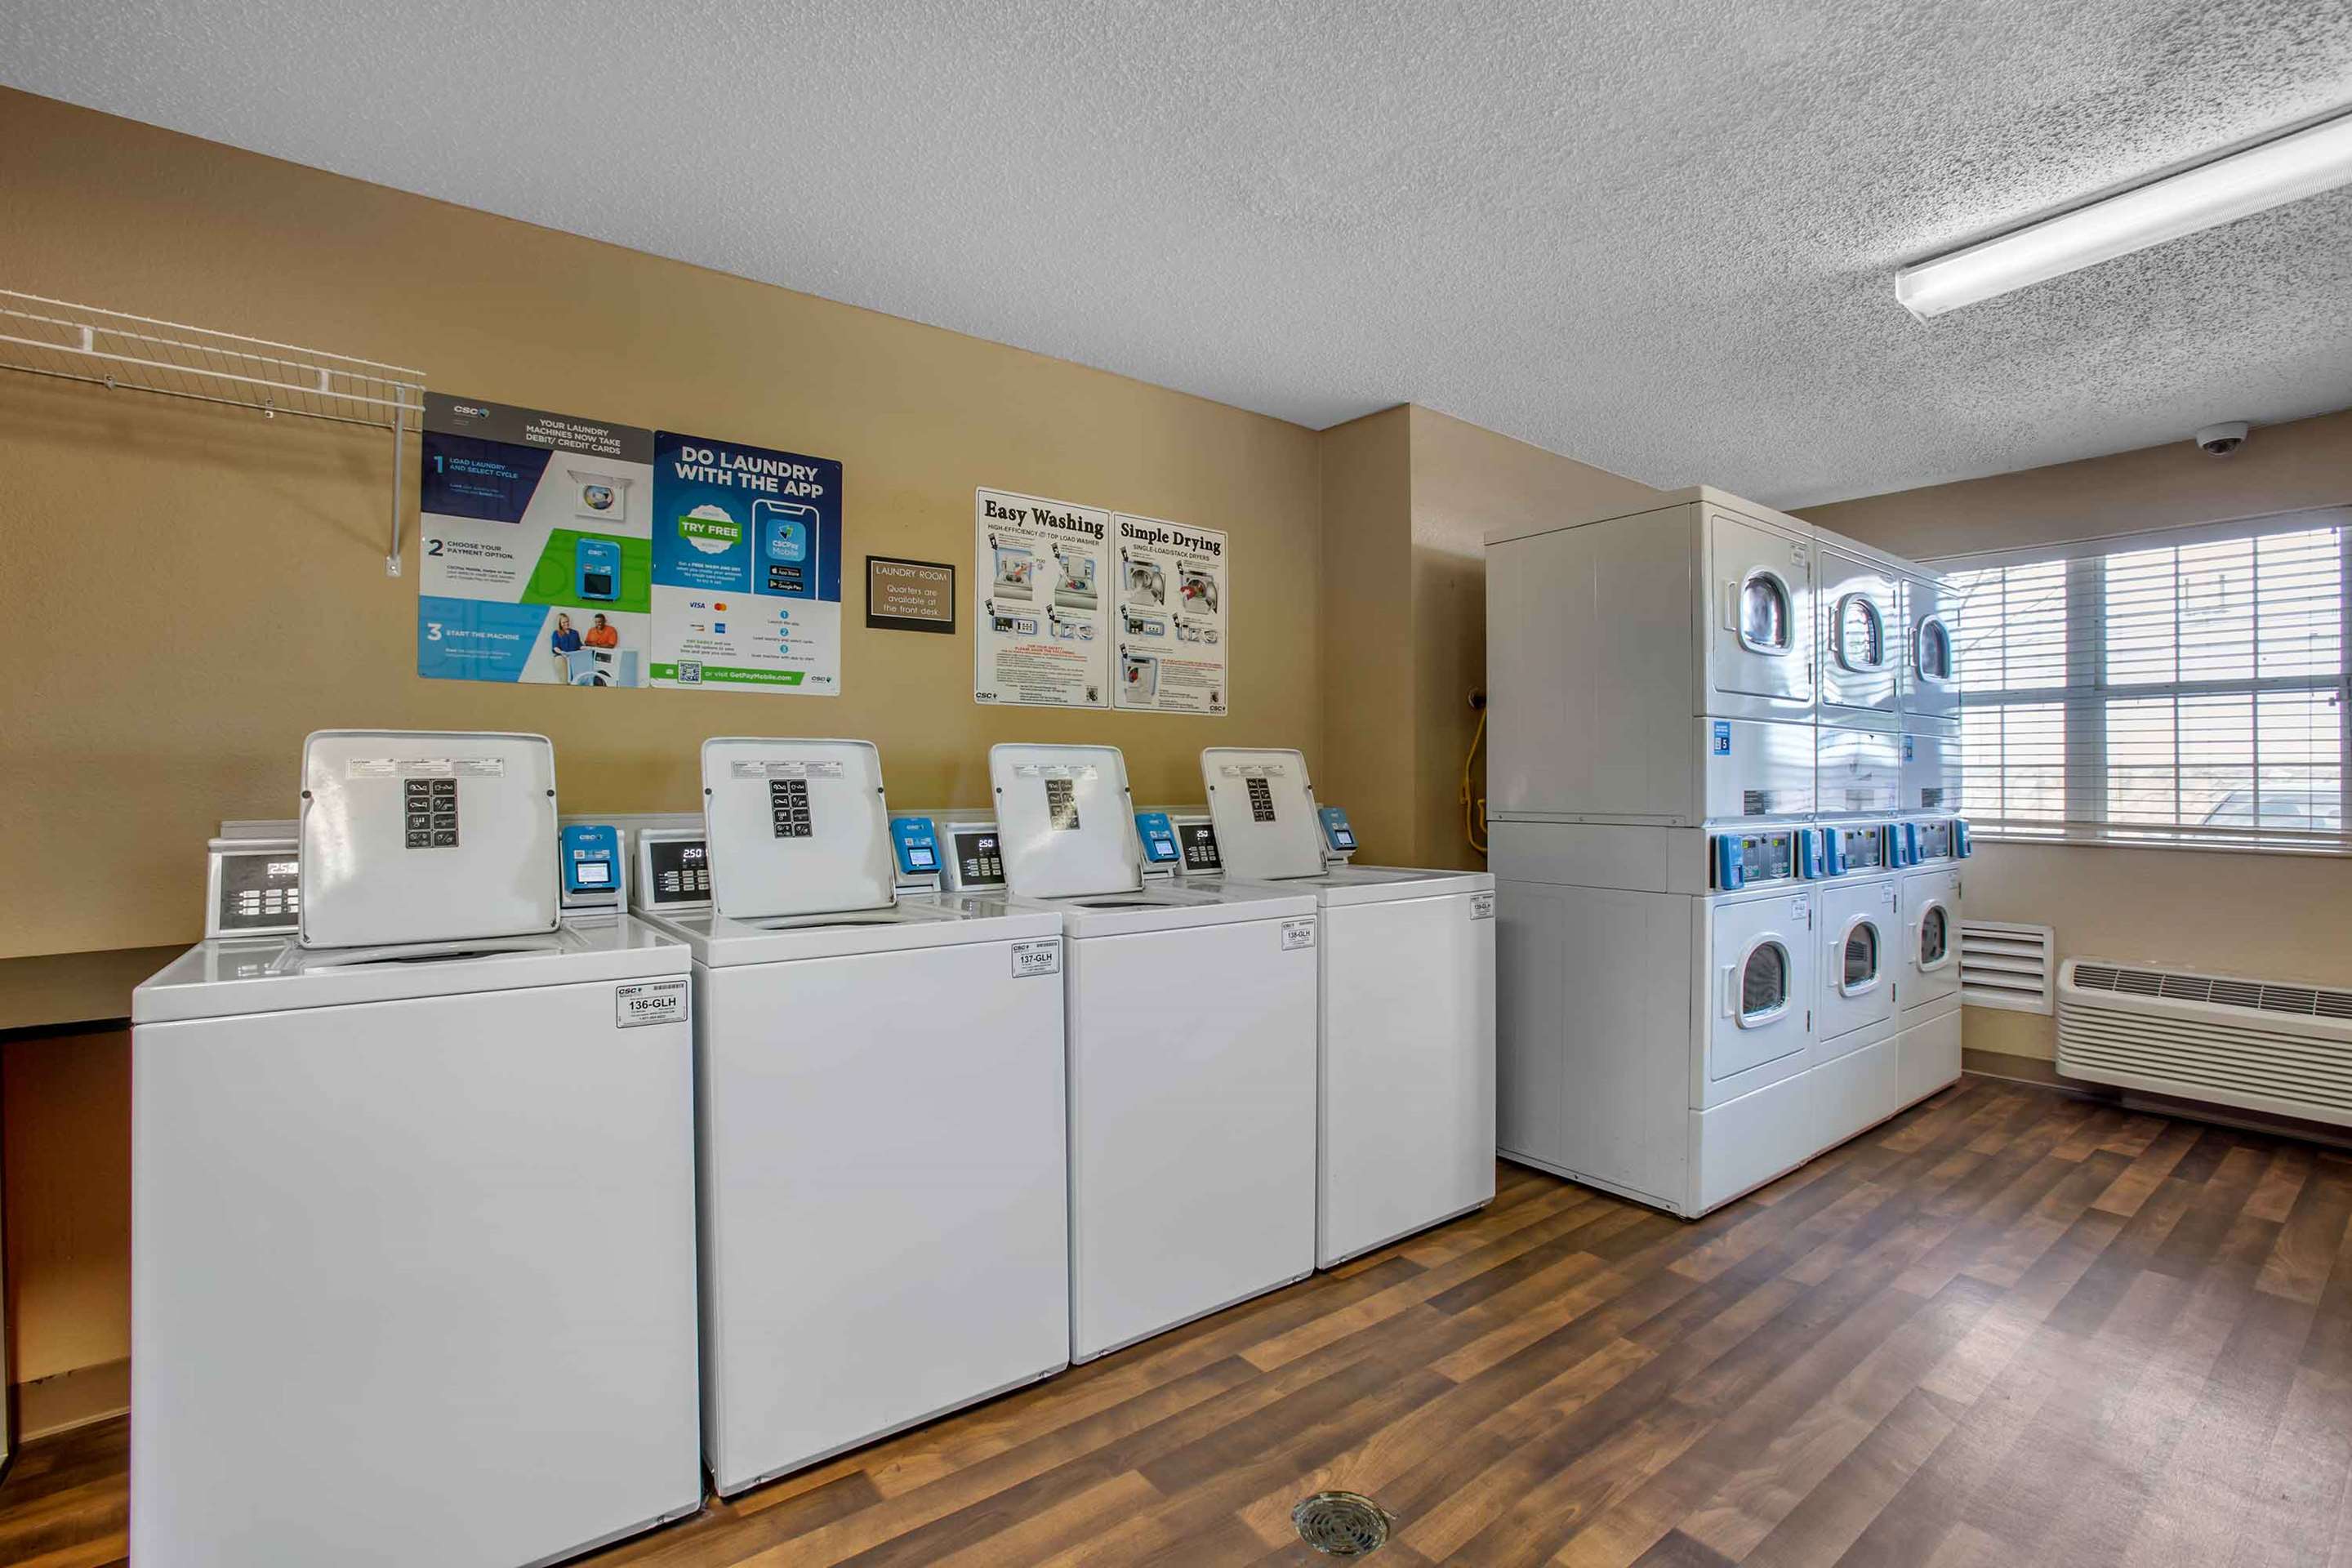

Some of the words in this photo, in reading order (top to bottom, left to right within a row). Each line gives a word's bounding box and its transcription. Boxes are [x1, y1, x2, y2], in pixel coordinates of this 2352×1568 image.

[454, 405, 478, 416] CSC
[540, 419, 565, 429] YOUR
[567, 423, 608, 435] LAUNDRY
[527, 425, 572, 439] MACHINES
[575, 433, 596, 442] NOW
[599, 437, 621, 447] TAKE
[527, 434, 555, 445] DEBIT/
[558, 439, 590, 449] CREDIT
[591, 444, 621, 454] CARDS
[434, 456, 443, 474] 1
[449, 458, 470, 466] LOAD
[472, 461, 506, 470] LAUNDRY
[682, 446, 714, 465] DO
[721, 452, 817, 481] LAUNDRY
[450, 465, 466, 473] AND
[468, 467, 494, 476] SELECT
[496, 470, 519, 479] CYCLE
[675, 463, 732, 485] WITH
[738, 473, 777, 492] THE
[784, 480, 823, 498] APP
[985, 500, 1027, 527] Easy
[1031, 508, 1104, 540] Washing
[683, 522, 705, 532] TRY
[709, 526, 738, 537] FREE
[988, 523, 1038, 537] HIGH-EFFICIENCY
[1076, 537, 1099, 546] WASHER
[448, 541, 479, 550] CHOOSE
[480, 543, 501, 551] YOUR
[1120, 523, 1169, 545] Simple
[1173, 531, 1221, 555] Drying
[429, 539, 443, 556] 2
[447, 548, 483, 557] PAYMENT
[1189, 553, 1209, 561] DRYERS
[876, 566, 915, 577] LAUNDRY
[920, 571, 947, 581] ROOM
[887, 585, 921, 595] Quarters
[889, 595, 924, 604] available
[900, 605, 917, 613] front
[427, 623, 442, 640] 3
[446, 630, 470, 638] START
[730, 672, 791, 681] GetPayMobile.com
[1021, 954, 1052, 963] 137-GLH
[630, 997, 676, 1009] 136-GLH
